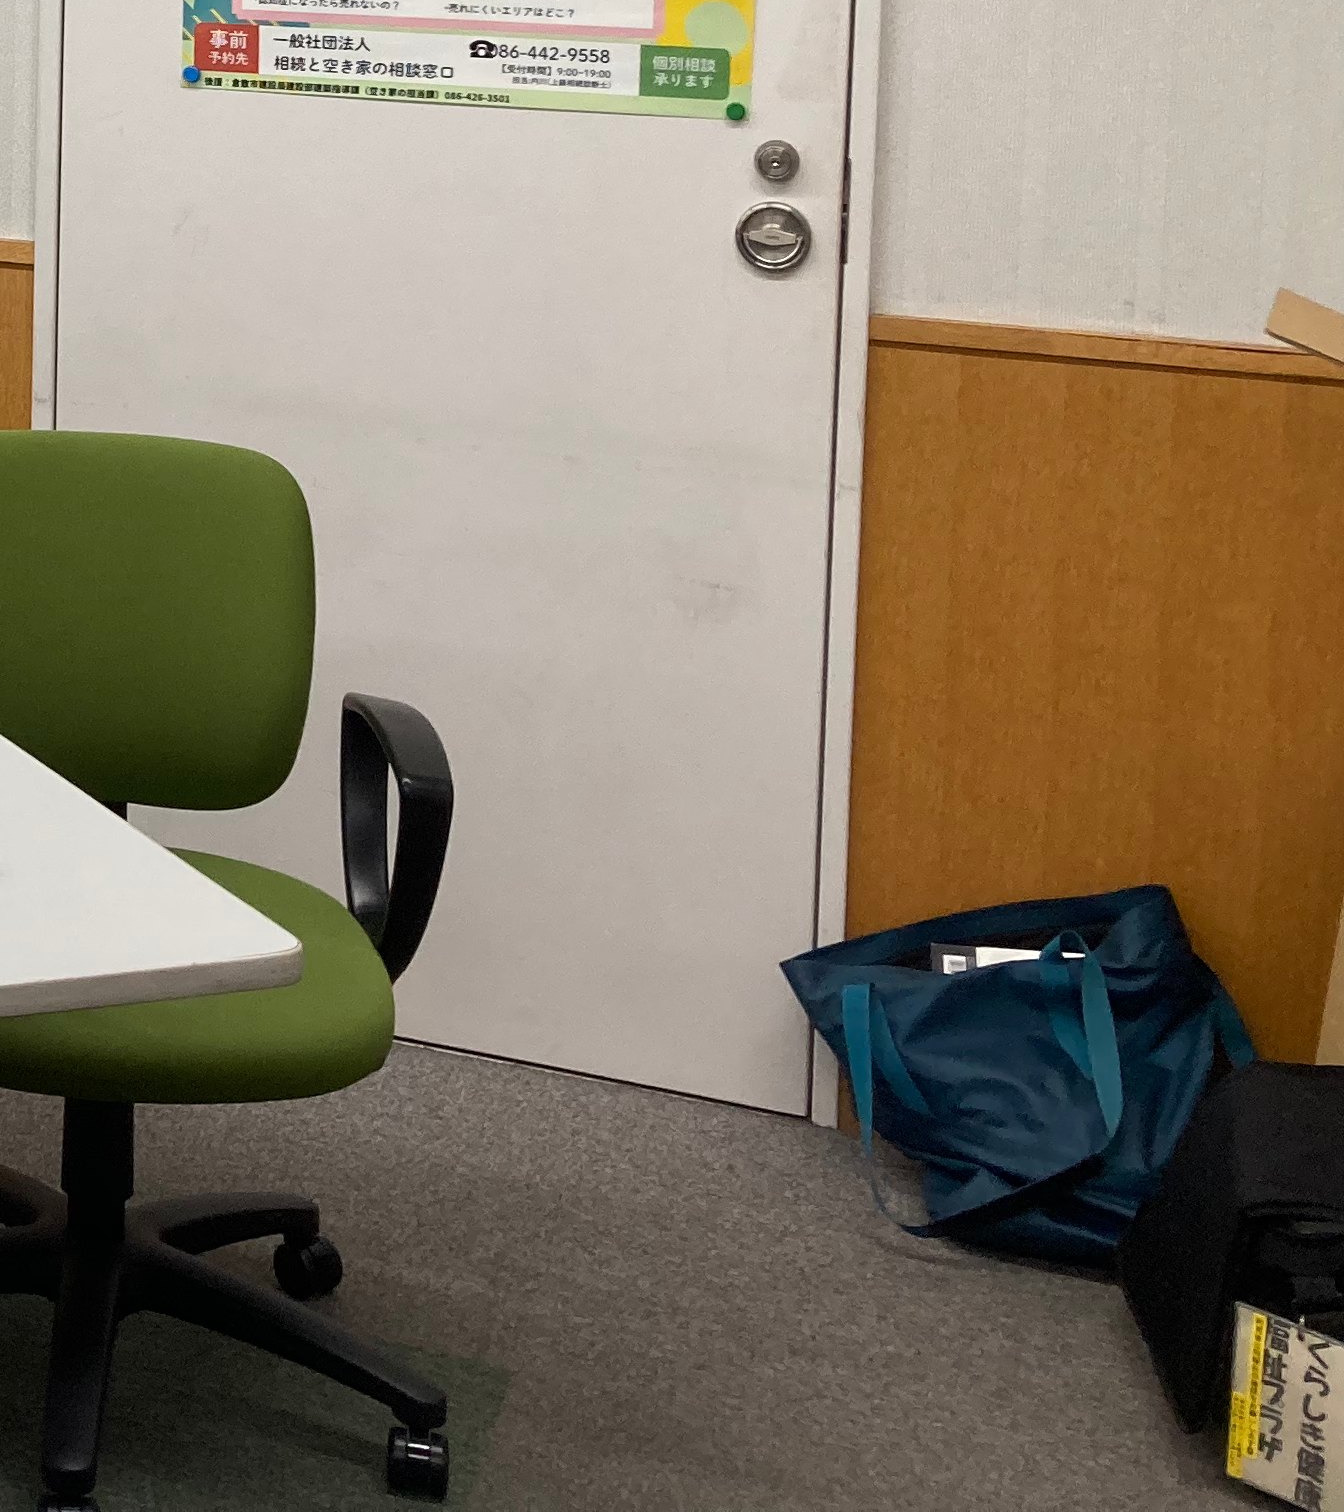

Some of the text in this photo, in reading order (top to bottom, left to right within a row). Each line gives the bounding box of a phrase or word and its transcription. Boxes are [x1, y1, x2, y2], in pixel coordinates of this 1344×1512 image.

[209, 29, 248, 49] 事前
[273, 34, 371, 52] 一般社団法人
[208, 51, 249, 66] 予約先
[274, 56, 454, 79] 相続と空き家の相談窓口
[652, 55, 716, 73] 個別相談
[653, 74, 714, 89] 承ります
